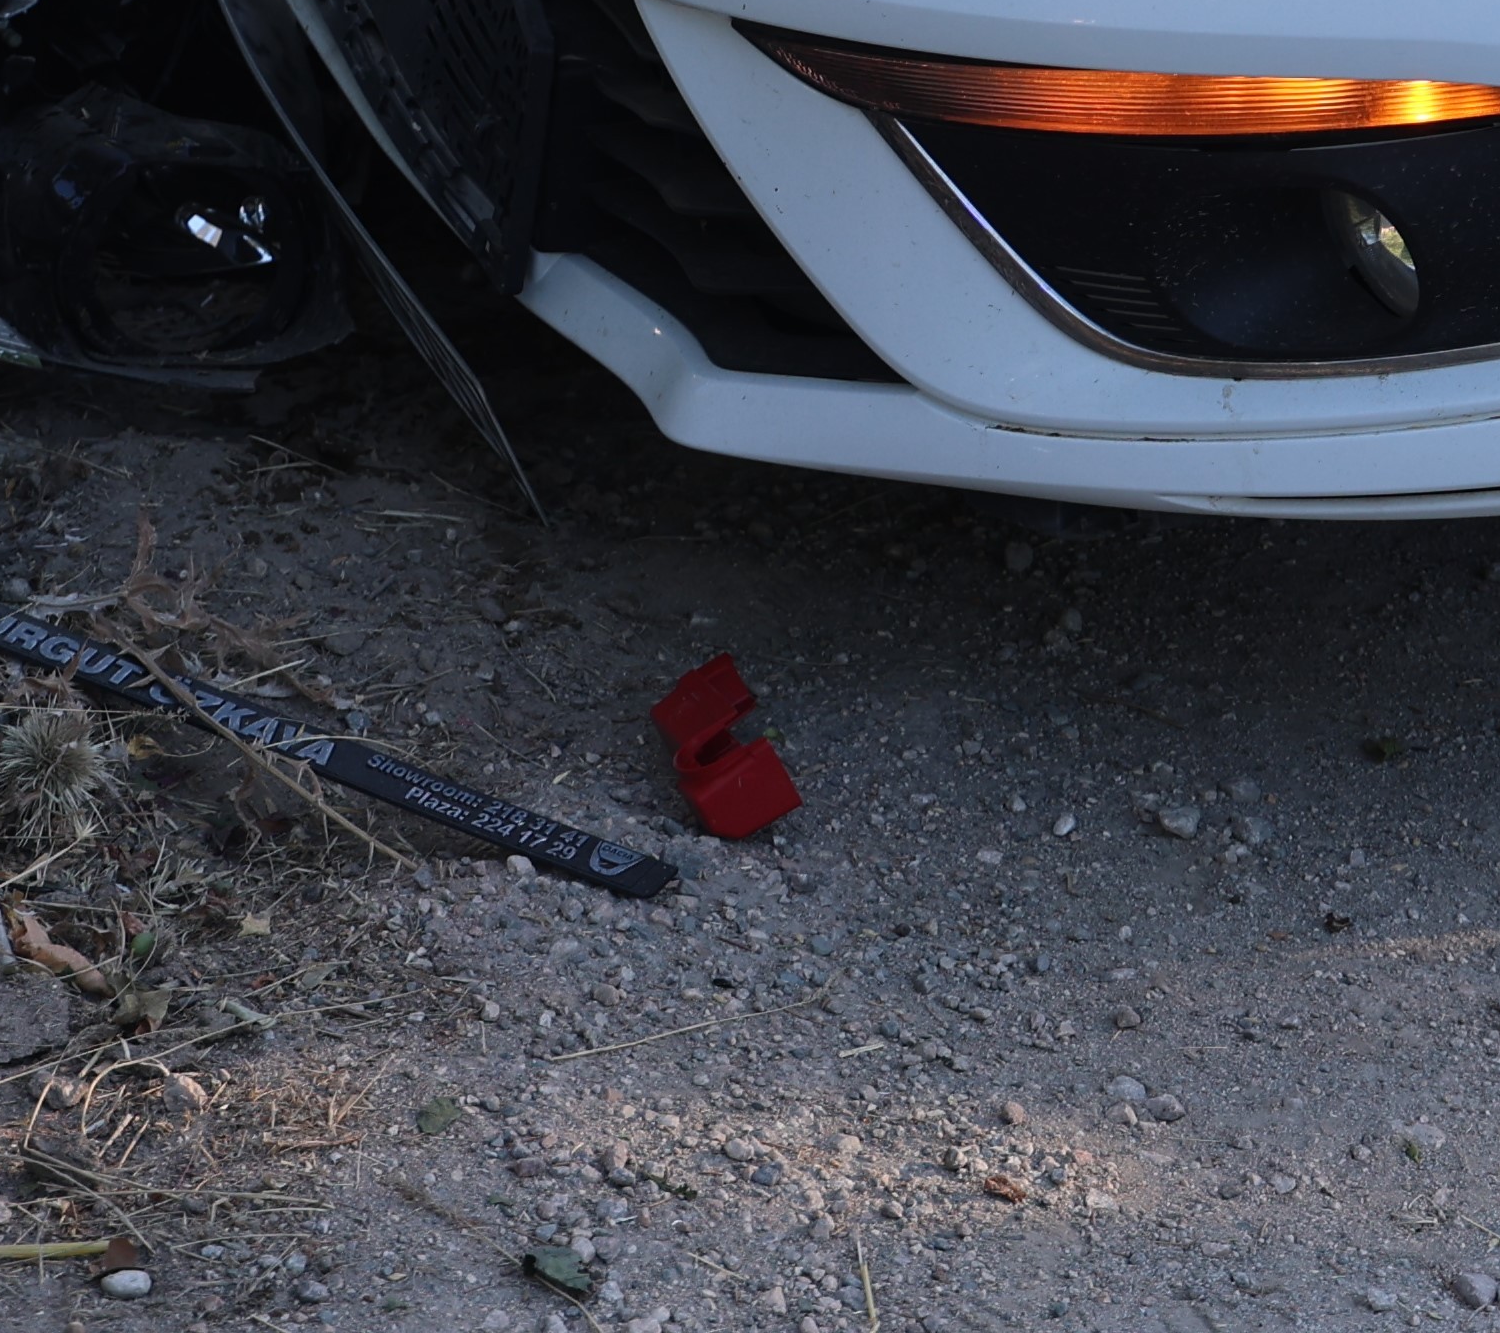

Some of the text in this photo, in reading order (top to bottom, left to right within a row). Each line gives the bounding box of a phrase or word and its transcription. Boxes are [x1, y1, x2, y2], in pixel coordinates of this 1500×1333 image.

[366, 753, 483, 808] Showroom:
[529, 815, 558, 836] 31
[560, 830, 590, 848] 41
[404, 785, 577, 861] Plaza: 224 17 29
